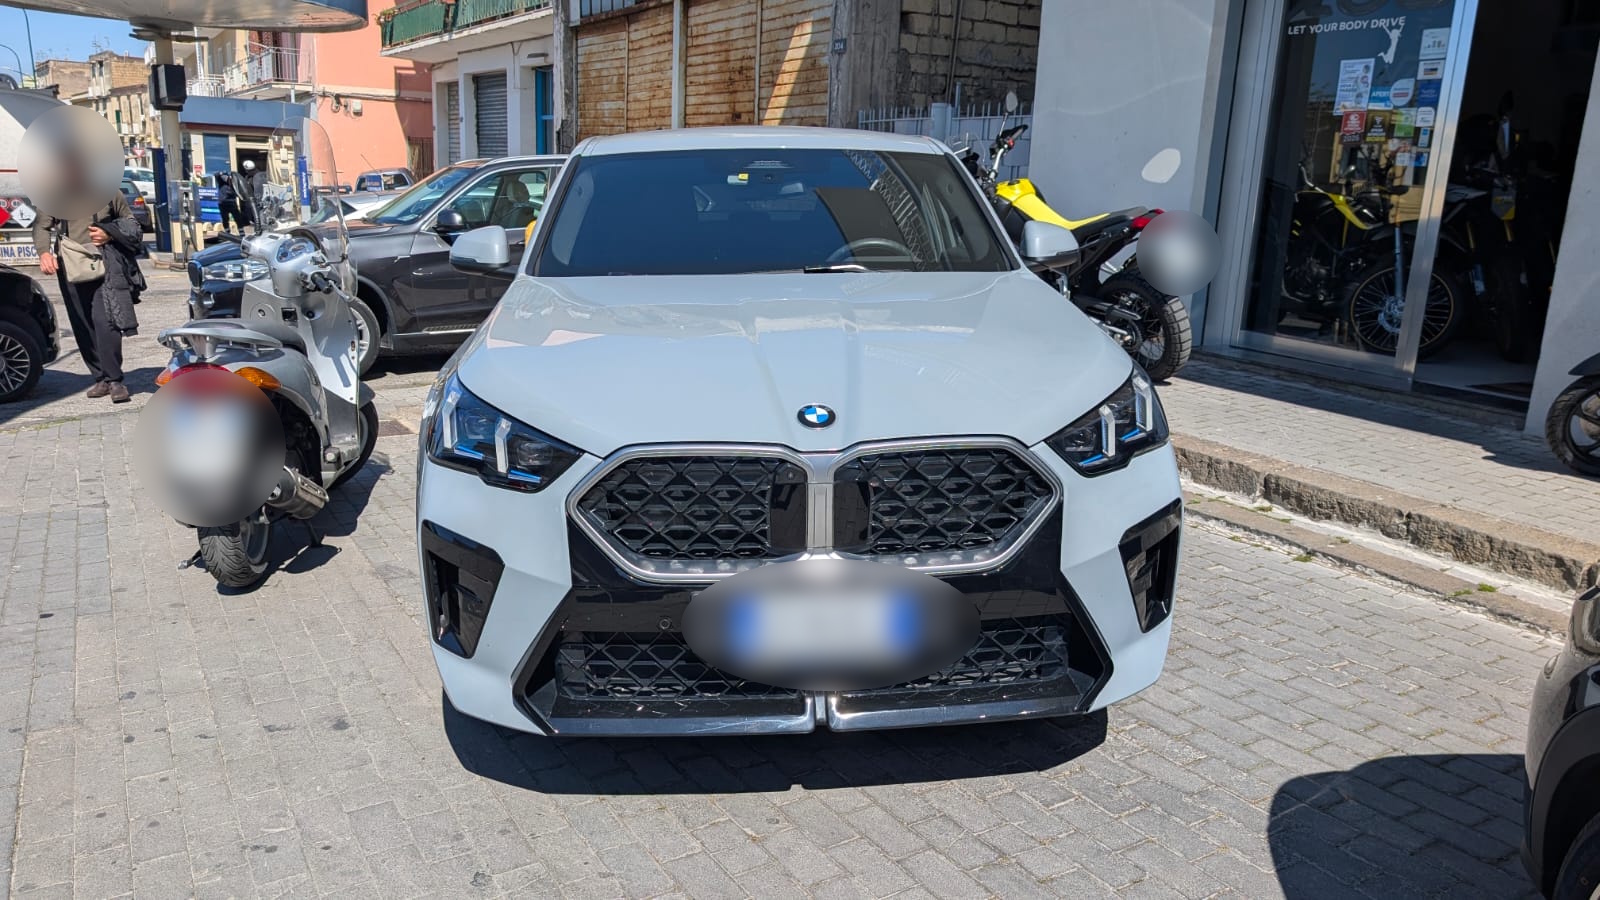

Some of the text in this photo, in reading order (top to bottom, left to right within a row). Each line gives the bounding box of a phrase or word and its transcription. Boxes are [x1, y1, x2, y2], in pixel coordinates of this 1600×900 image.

[1287, 15, 1406, 35] LET YOUR BODY DRIVE
[17, 246, 38, 257] PISC
